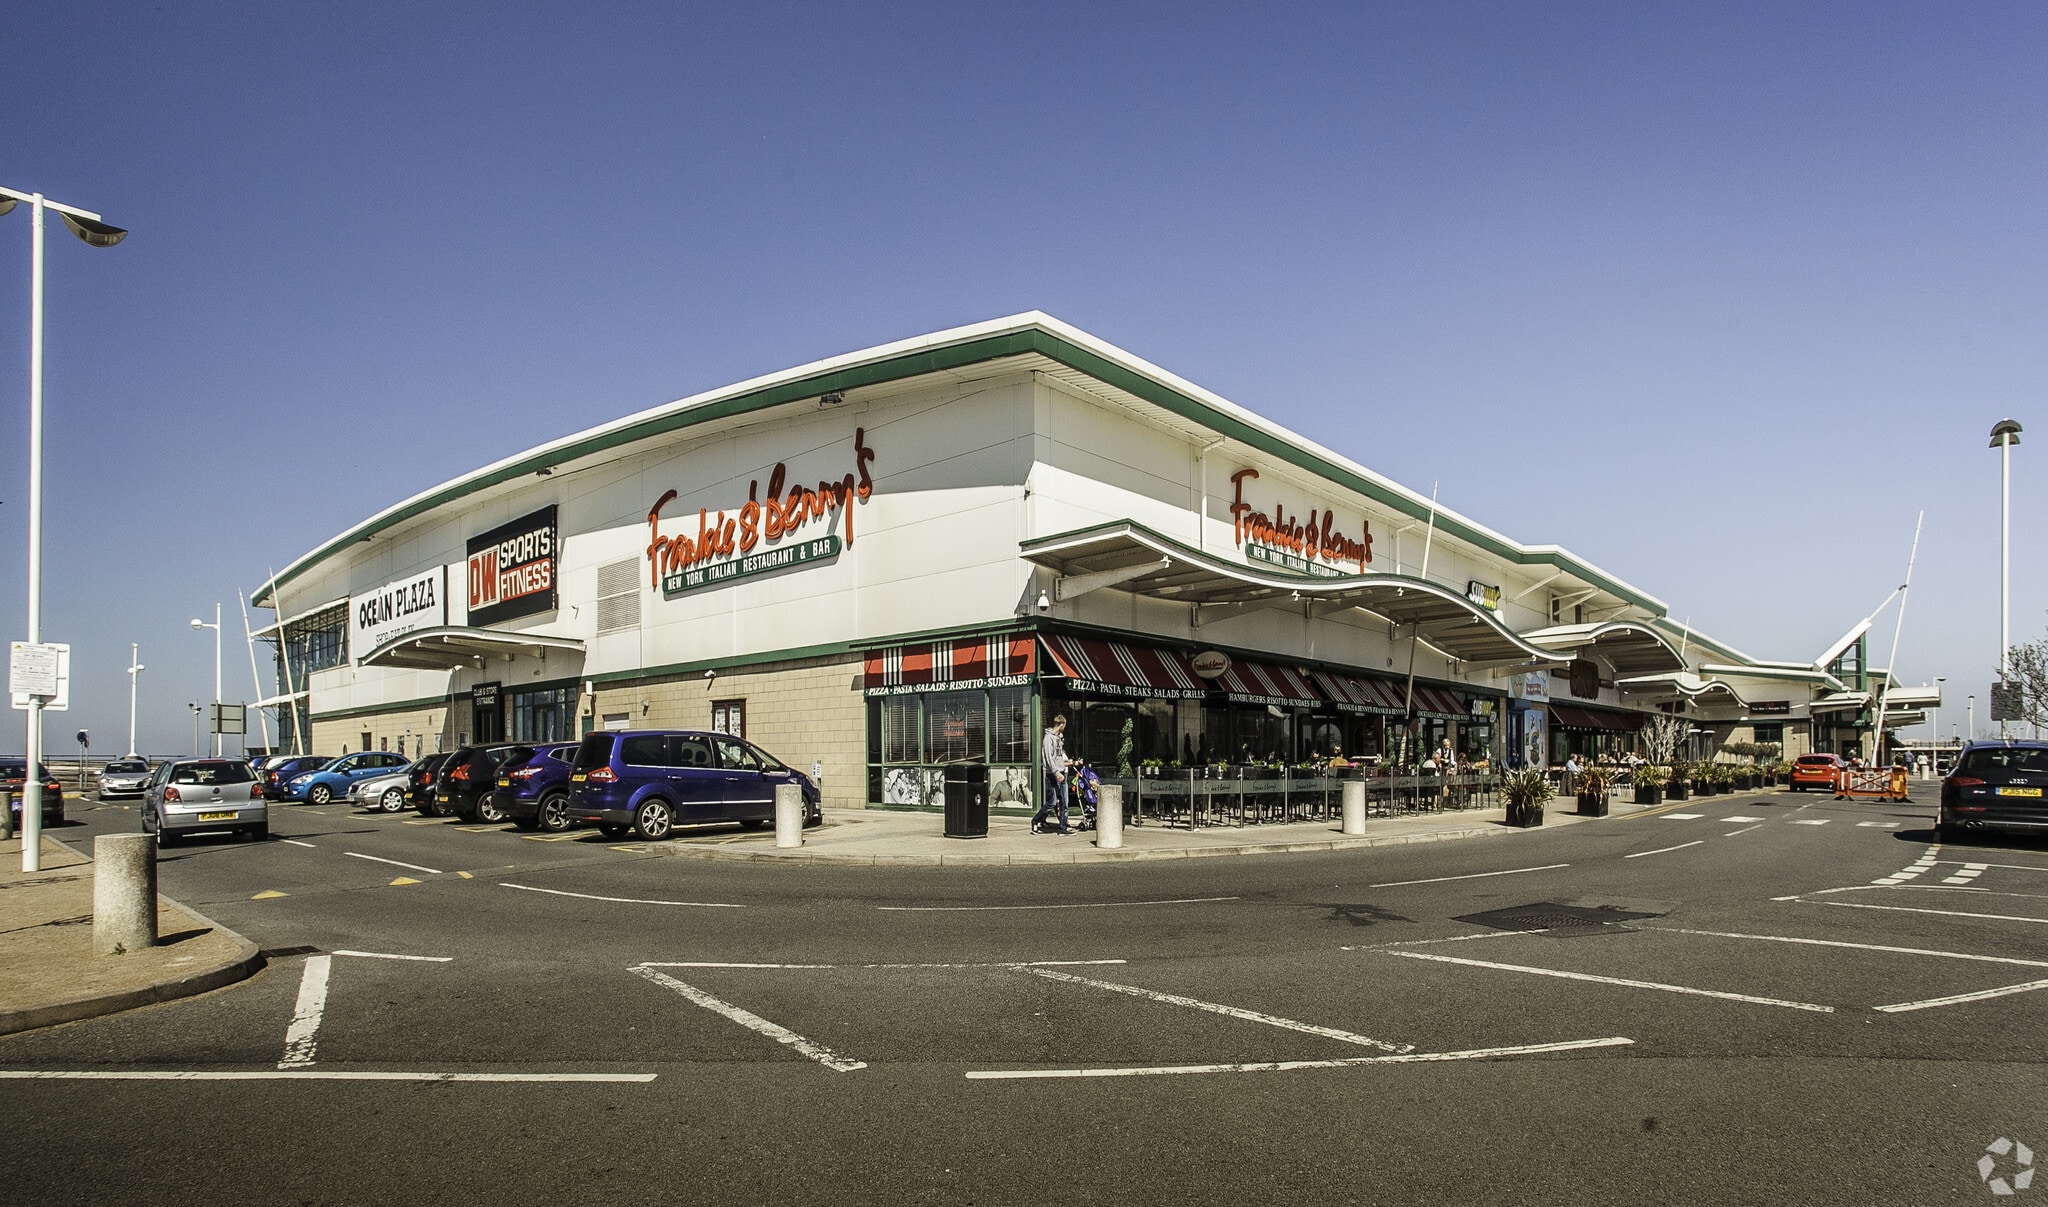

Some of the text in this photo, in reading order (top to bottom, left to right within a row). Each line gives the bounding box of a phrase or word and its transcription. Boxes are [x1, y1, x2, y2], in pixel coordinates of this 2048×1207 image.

[647, 489, 736, 587] Frankie
[764, 427, 875, 546] Benny's
[1230, 469, 1304, 554] Frankie
[1320, 510, 1373, 575] Benny's
[500, 526, 550, 569] SPORTS
[667, 539, 831, 591] NEW YORK ITALIAN RESTAURANT & BAR
[1253, 546, 1266, 559] NEW
[1269, 551, 1284, 564] YORK
[1287, 554, 1307, 569] ITALIAN
[469, 548, 499, 609] DW
[500, 561, 550, 600] FITNESS
[1469, 582, 1500, 609] SUBWAY
[359, 577, 436, 630] OCEAN PLAZA
[869, 674, 1028, 696] PIZZA PASTA SALADS RISOTTO SUNDAES
[1072, 679, 1206, 699] PIZZA PASTA STEAKS SALADS GRILLS
[1228, 693, 1266, 704] HAMBURGERS
[1267, 696, 1288, 706] RISOTTO
[1288, 698, 1310, 708] SUNDAES
[1471, 699, 1494, 716] SUBWAY
